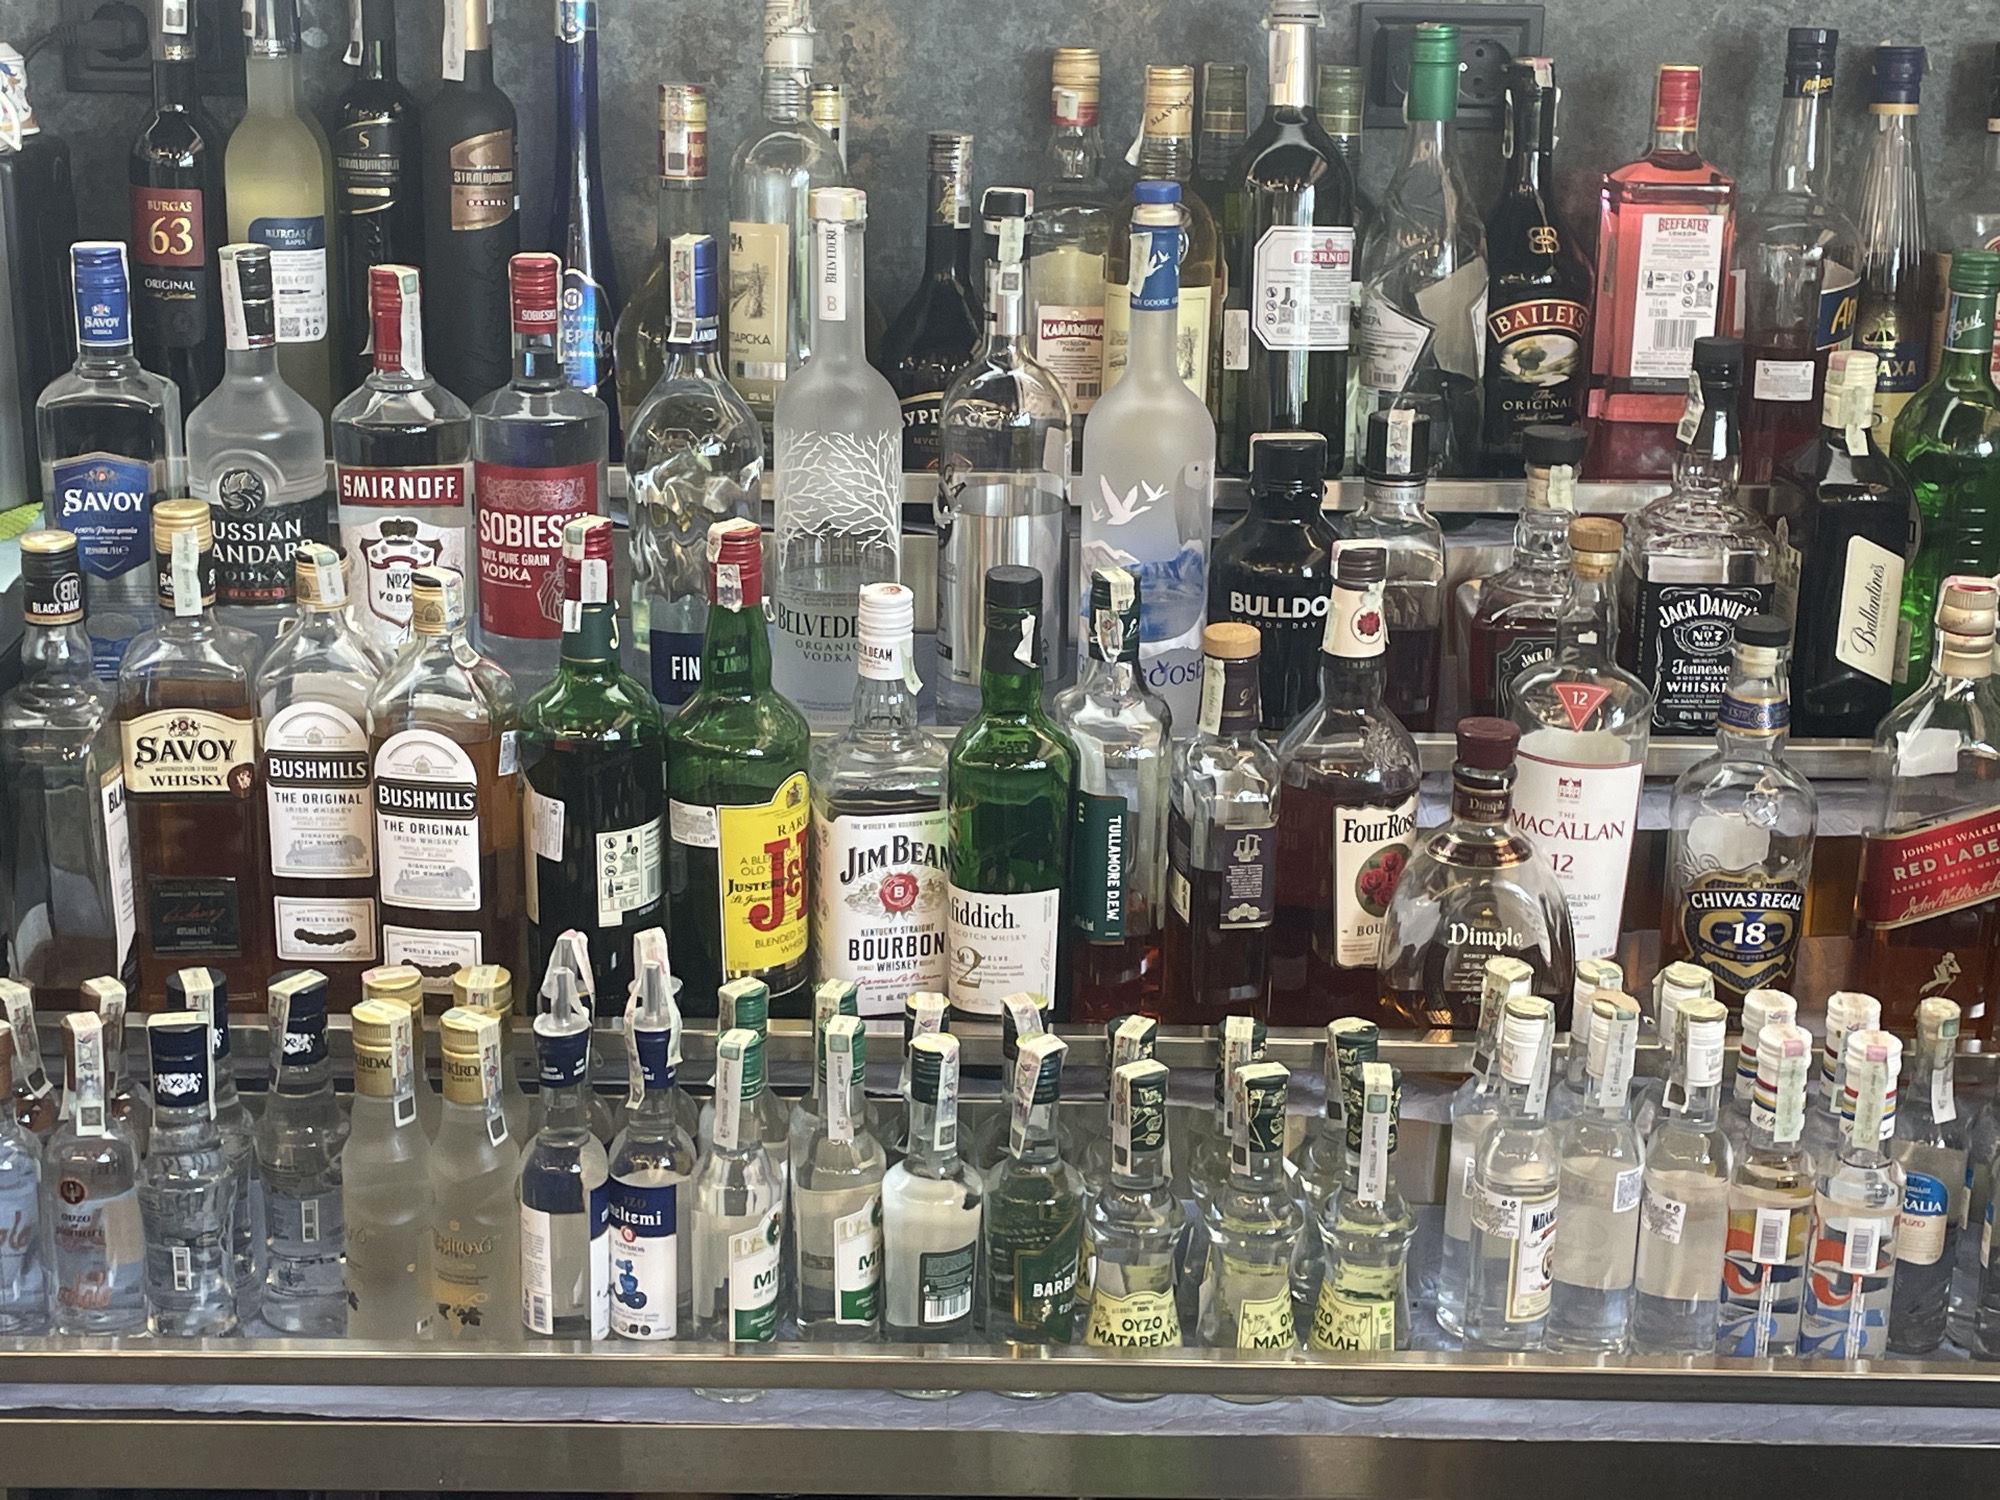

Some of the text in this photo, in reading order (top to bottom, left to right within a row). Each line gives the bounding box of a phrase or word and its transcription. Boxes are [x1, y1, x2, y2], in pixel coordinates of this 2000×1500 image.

[148, 200, 192, 212] BURGAS
[150, 218, 194, 255] 63
[265, 228, 306, 241] BURGAS
[1657, 217, 1710, 235] BEEFEATER
[824, 227, 837, 285] BELVEDERE
[145, 279, 196, 291] ORIGINAL
[84, 315, 120, 329] SAVOY
[1494, 305, 1586, 334] BAILEYS
[1877, 360, 1917, 378] AXA
[342, 475, 456, 500] SMIRNOFF
[63, 489, 144, 517] SAVOY
[211, 518, 301, 541] USSIAN
[479, 509, 588, 549] SOBIES
[212, 539, 312, 564] ANDAR
[498, 552, 520, 566] PURE
[521, 553, 550, 567] GRAIN
[482, 562, 531, 582] VODKA
[32, 602, 60, 614] BLACK
[377, 591, 411, 604] VODK
[1230, 591, 1330, 618] BULLDO
[1850, 561, 1887, 656] Ballantine's
[778, 605, 859, 639] BELVEDE
[1659, 599, 1697, 628] JACK
[803, 651, 852, 663] VODKA
[1521, 651, 1544, 668] JACK
[1671, 658, 1731, 675] Tennesse
[1572, 690, 1589, 706] 12
[1666, 681, 1727, 693] WHISK
[134, 736, 238, 770] SAVOY
[269, 757, 367, 780] BUSHMILLS
[149, 774, 226, 787] WHISKY
[274, 791, 364, 805] THE ORIGINAL
[377, 784, 475, 810] BUSHMILLS
[1510, 808, 1626, 842] MACALLAN
[1558, 811, 1576, 819] THE
[383, 818, 470, 837] THE ORIGINAL
[1342, 818, 1381, 844] Four
[420, 837, 459, 846] WHISKEY
[1107, 814, 1122, 887] TULLAMORE
[1902, 838, 1954, 862] JOHNNIE
[839, 844, 888, 886] JIM
[1550, 854, 1574, 873] 12
[1893, 838, 2000, 881] RED LABE
[951, 896, 1014, 929] fiddich
[1691, 891, 1802, 911] CHIVAS REGAL
[860, 923, 935, 937] KENTUCKY STRAIGHT
[1447, 922, 1523, 952] Dimple
[1732, 922, 1767, 945] 18
[849, 932, 945, 961] BOURBON
[876, 959, 918, 972] WHISKEY
